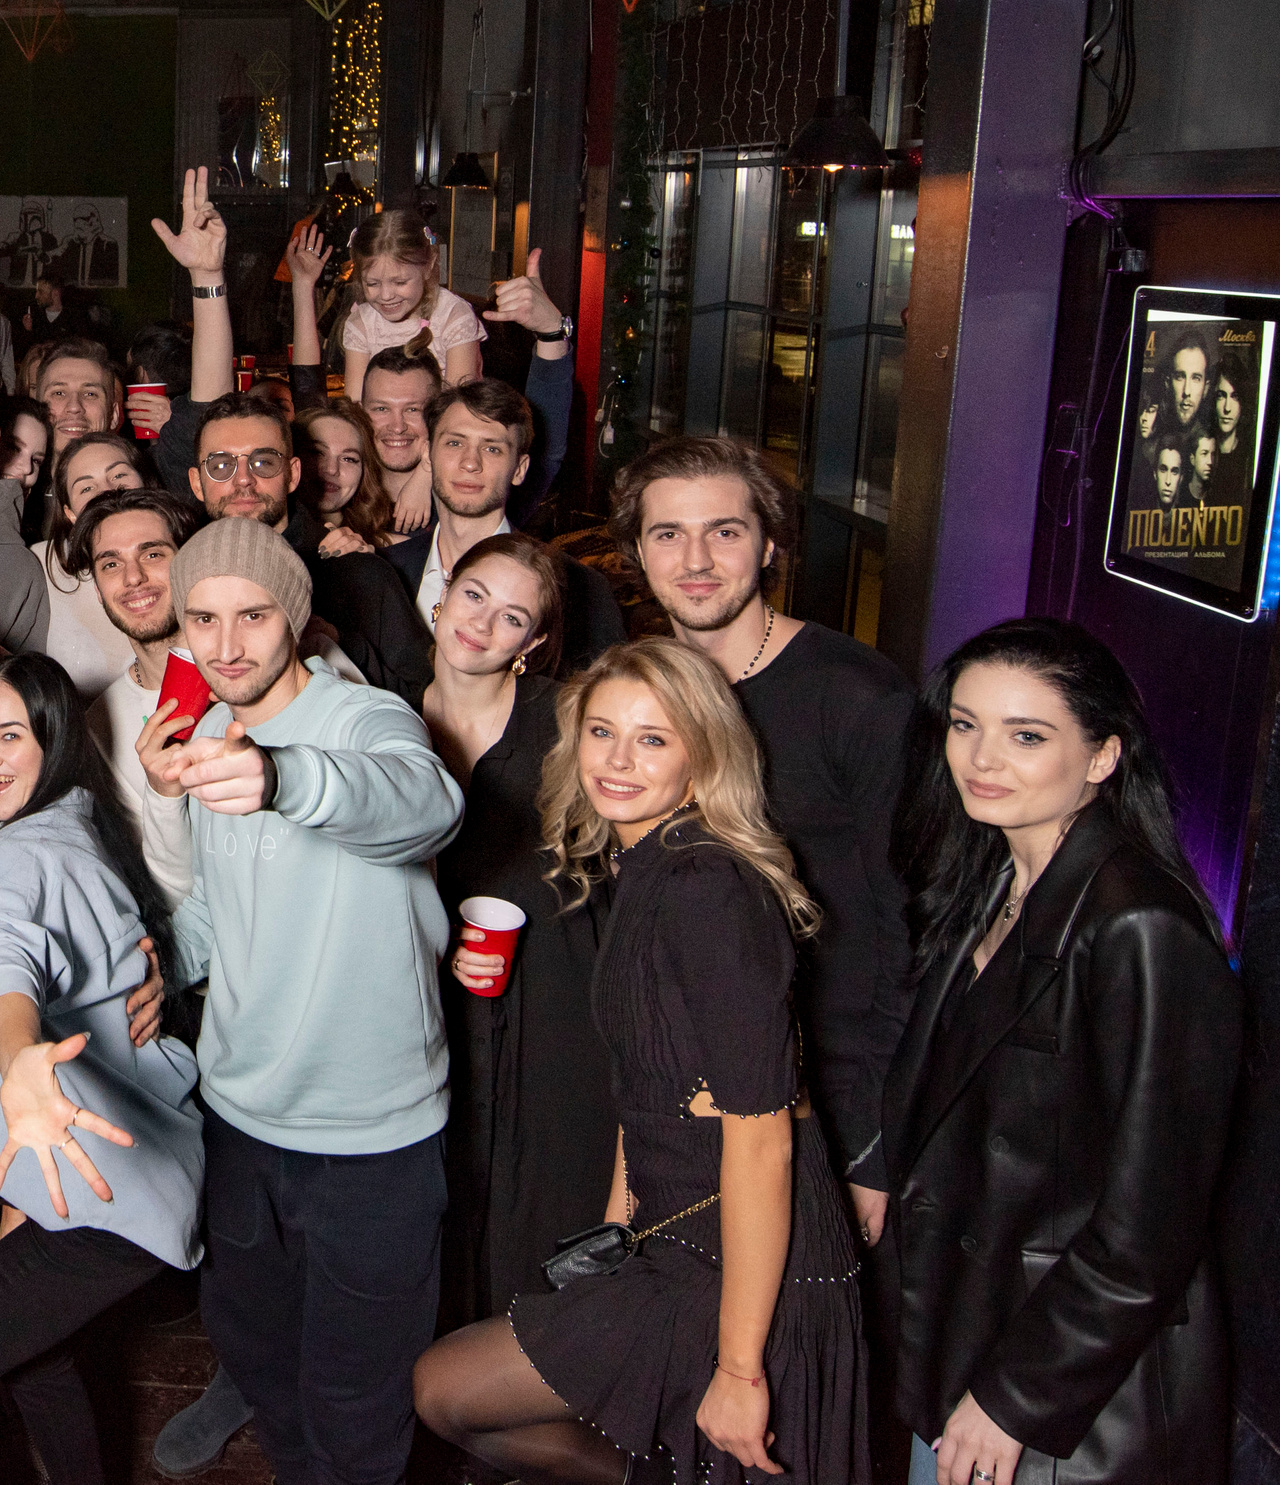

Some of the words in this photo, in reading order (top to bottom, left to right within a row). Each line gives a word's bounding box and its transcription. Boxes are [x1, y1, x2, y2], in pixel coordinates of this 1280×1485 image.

[1144, 330, 1156, 357] 4
[1218, 329, 1256, 342] Москва
[1126, 505, 1243, 553] MOJENTO
